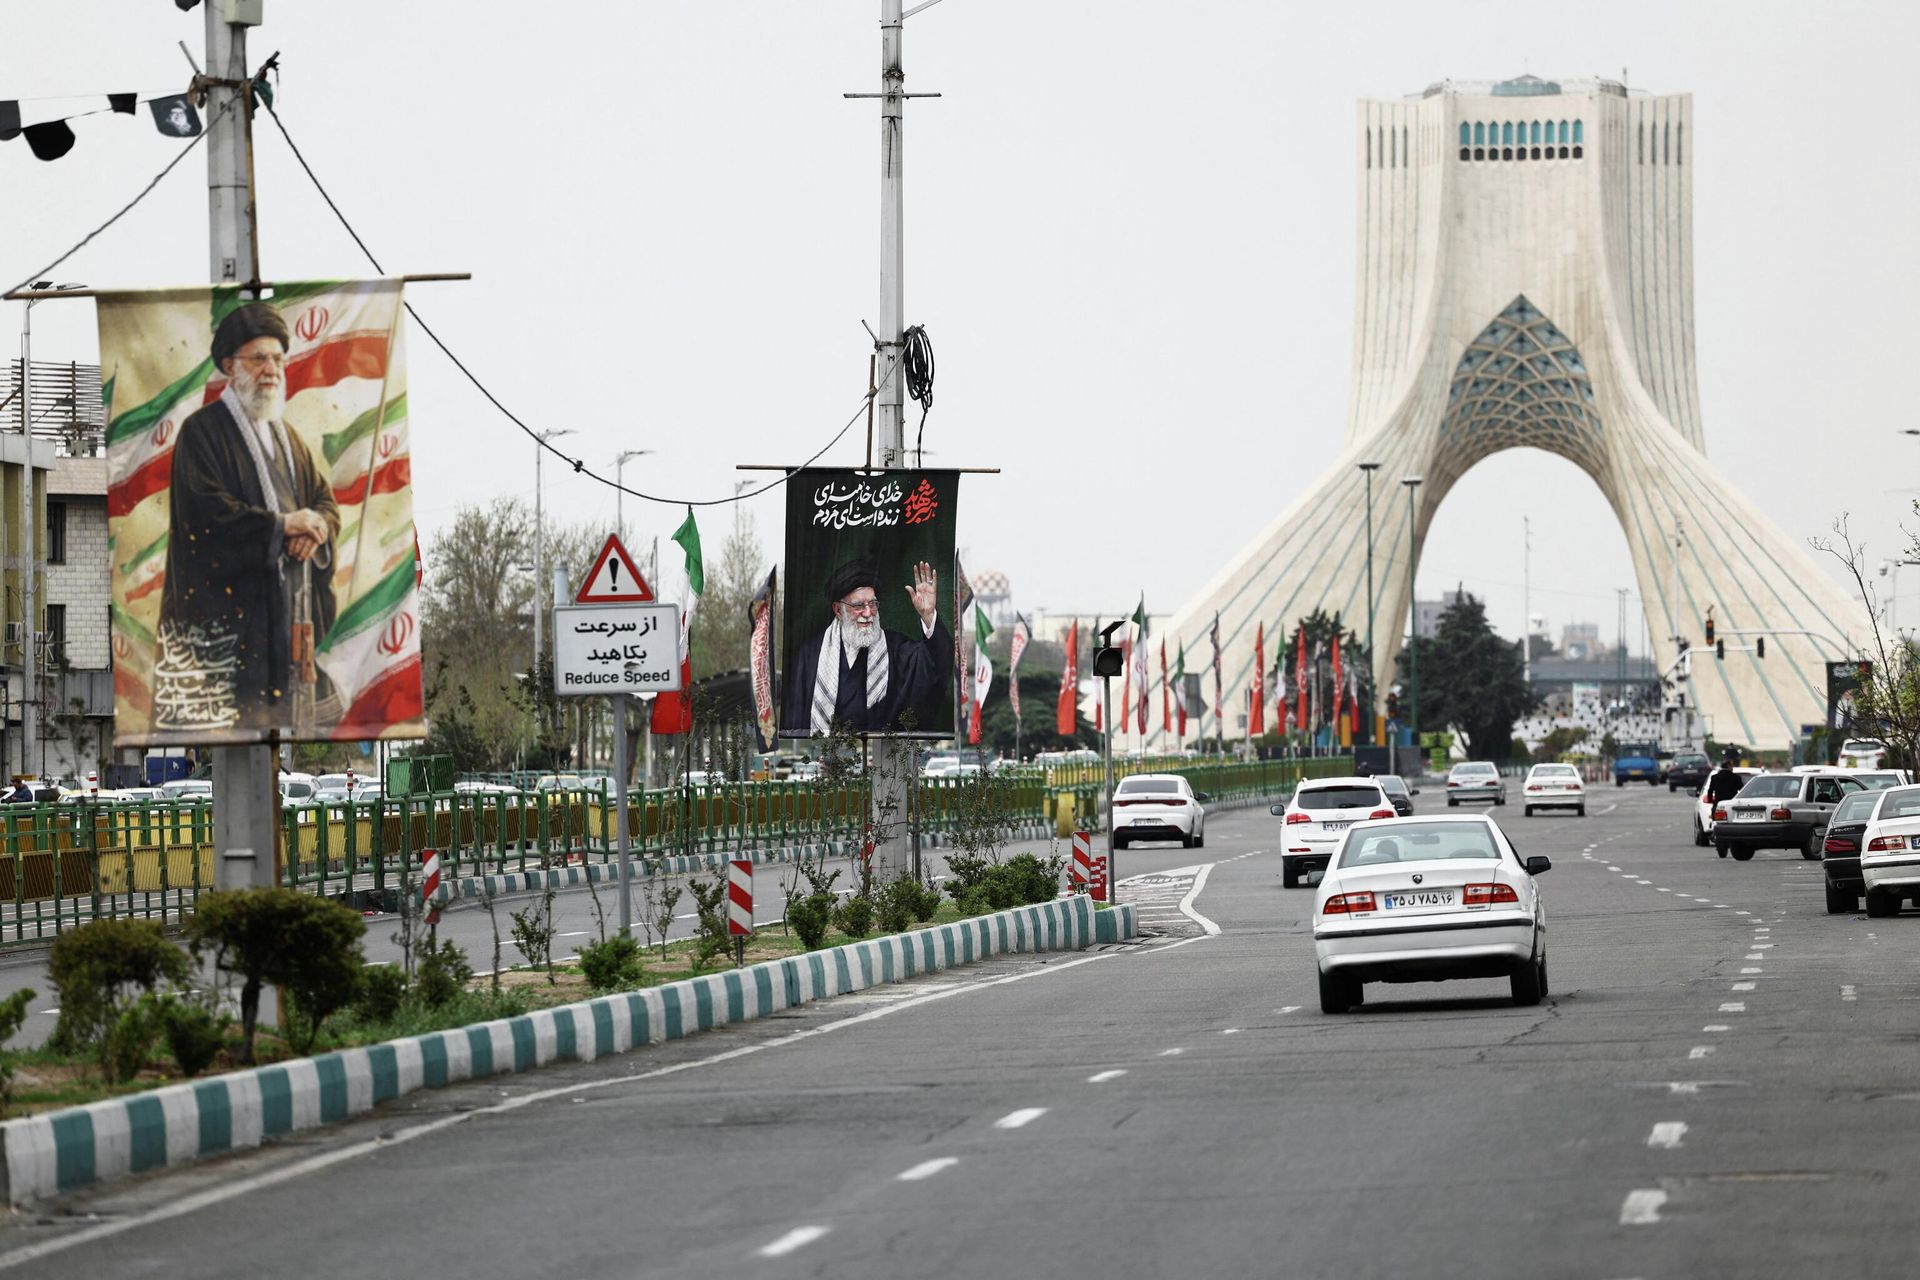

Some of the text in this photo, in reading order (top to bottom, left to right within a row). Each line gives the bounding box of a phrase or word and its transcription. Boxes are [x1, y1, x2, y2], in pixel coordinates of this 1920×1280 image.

[574, 616, 657, 637] از سرعت
[587, 645, 647, 664] بکاهید
[565, 669, 670, 685] Reduce Speed
[1418, 894, 1439, 905] ۷۸۵
